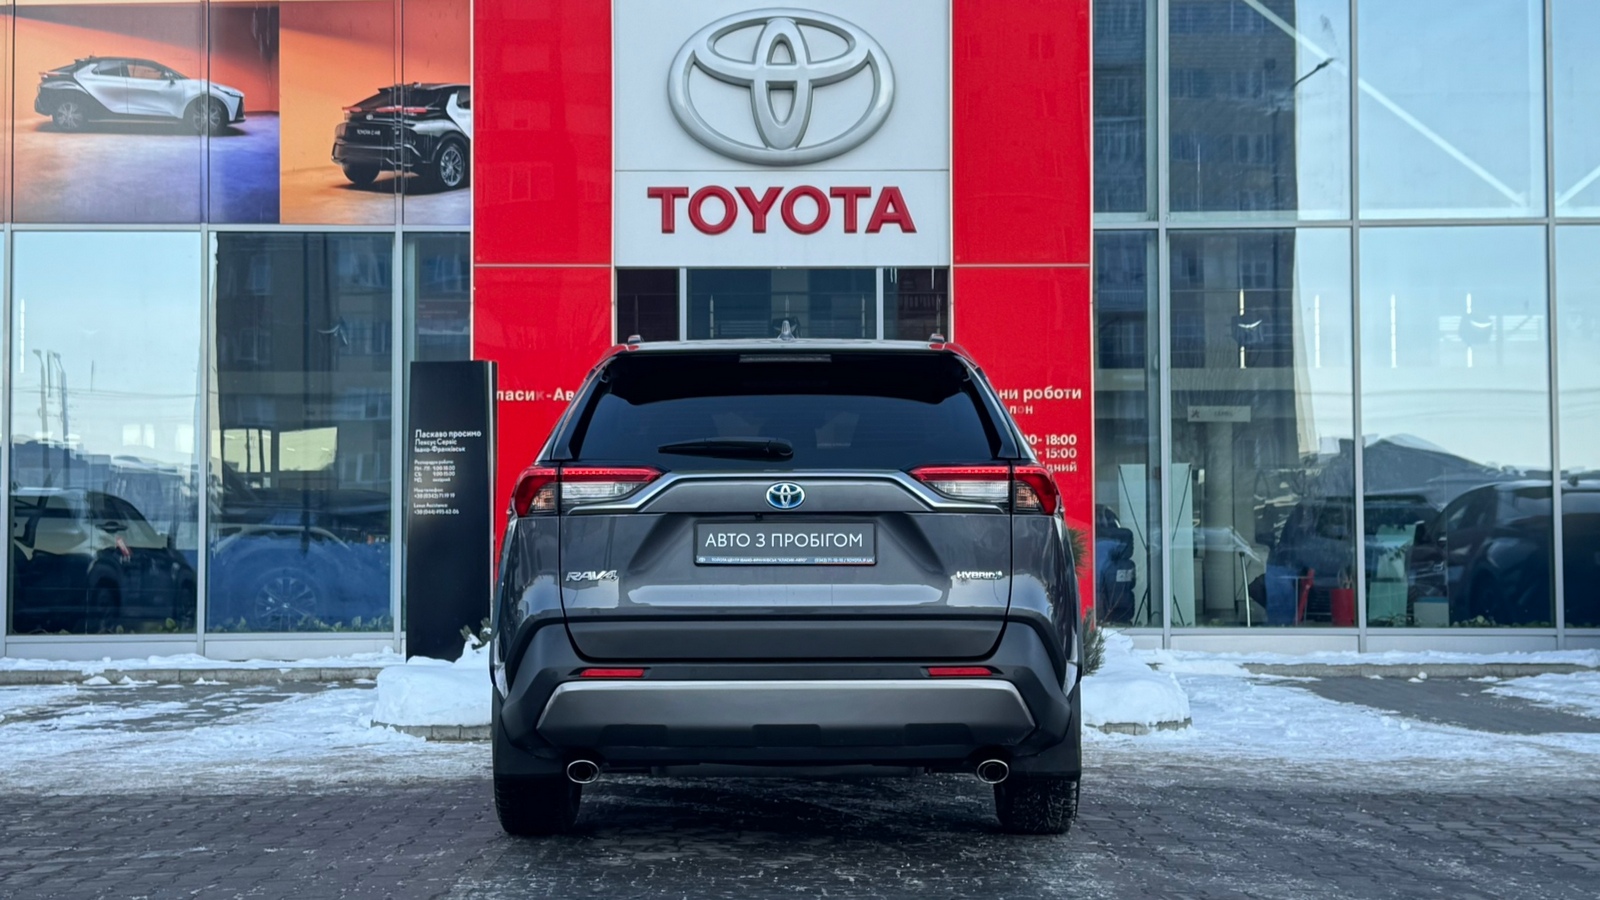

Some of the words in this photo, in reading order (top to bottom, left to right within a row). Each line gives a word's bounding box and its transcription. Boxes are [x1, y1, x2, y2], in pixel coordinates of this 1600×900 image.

[647, 185, 918, 235] TOYOTA
[998, 389, 1018, 400] ни
[1023, 386, 1082, 403] роботи
[1010, 406, 1033, 414] лон
[415, 429, 447, 438] Ласкаво
[449, 431, 481, 439] просимо
[1045, 434, 1077, 446] 18:00
[1045, 448, 1077, 459] 15:00
[1042, 461, 1077, 473] дний
[705, 533, 750, 547] АВТО
[755, 533, 766, 547] З
[771, 533, 863, 547] ПРОБІГОМ
[565, 570, 619, 582] RAV4
[956, 571, 997, 579] HYBRID
